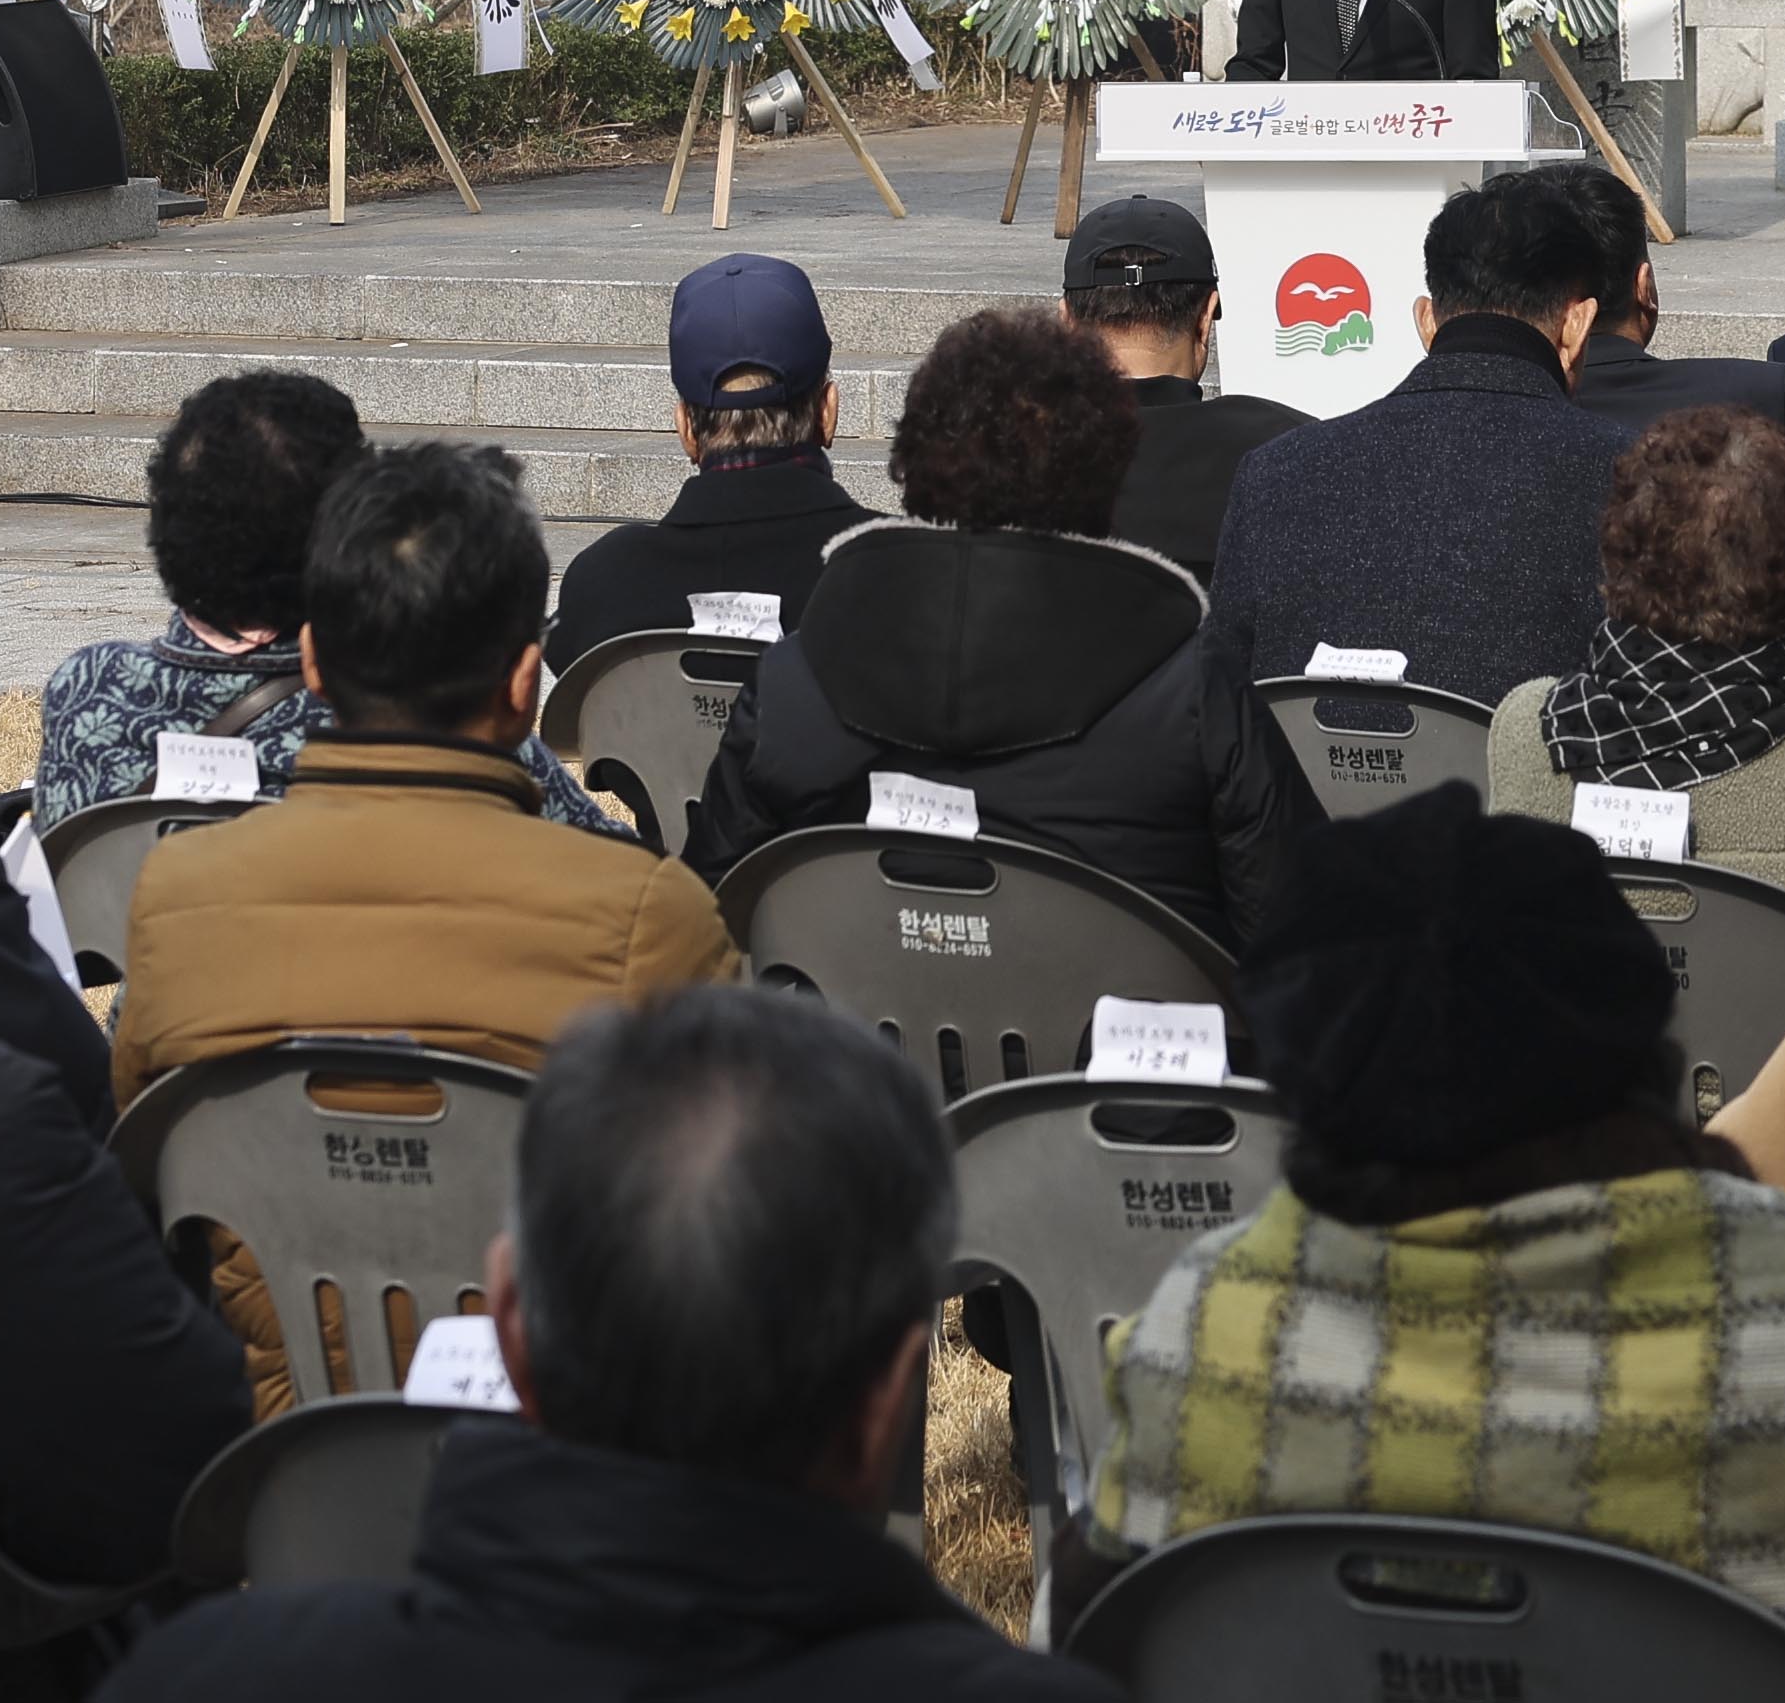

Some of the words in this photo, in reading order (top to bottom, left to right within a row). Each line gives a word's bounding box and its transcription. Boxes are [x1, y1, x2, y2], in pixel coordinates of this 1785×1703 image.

[1172, 110, 1223, 134] 새로운
[1223, 109, 1270, 139] 도약
[1270, 115, 1309, 136] 글로벌
[1313, 118, 1339, 136] 융합
[1344, 118, 1370, 136] 도시
[1373, 113, 1406, 136] 인천
[1408, 103, 1453, 138] 중구
[1328, 745, 1405, 771] 한성렌탈
[898, 908, 990, 942] 한성렌탈
[1121, 1178, 1234, 1213] 한성렌탈
